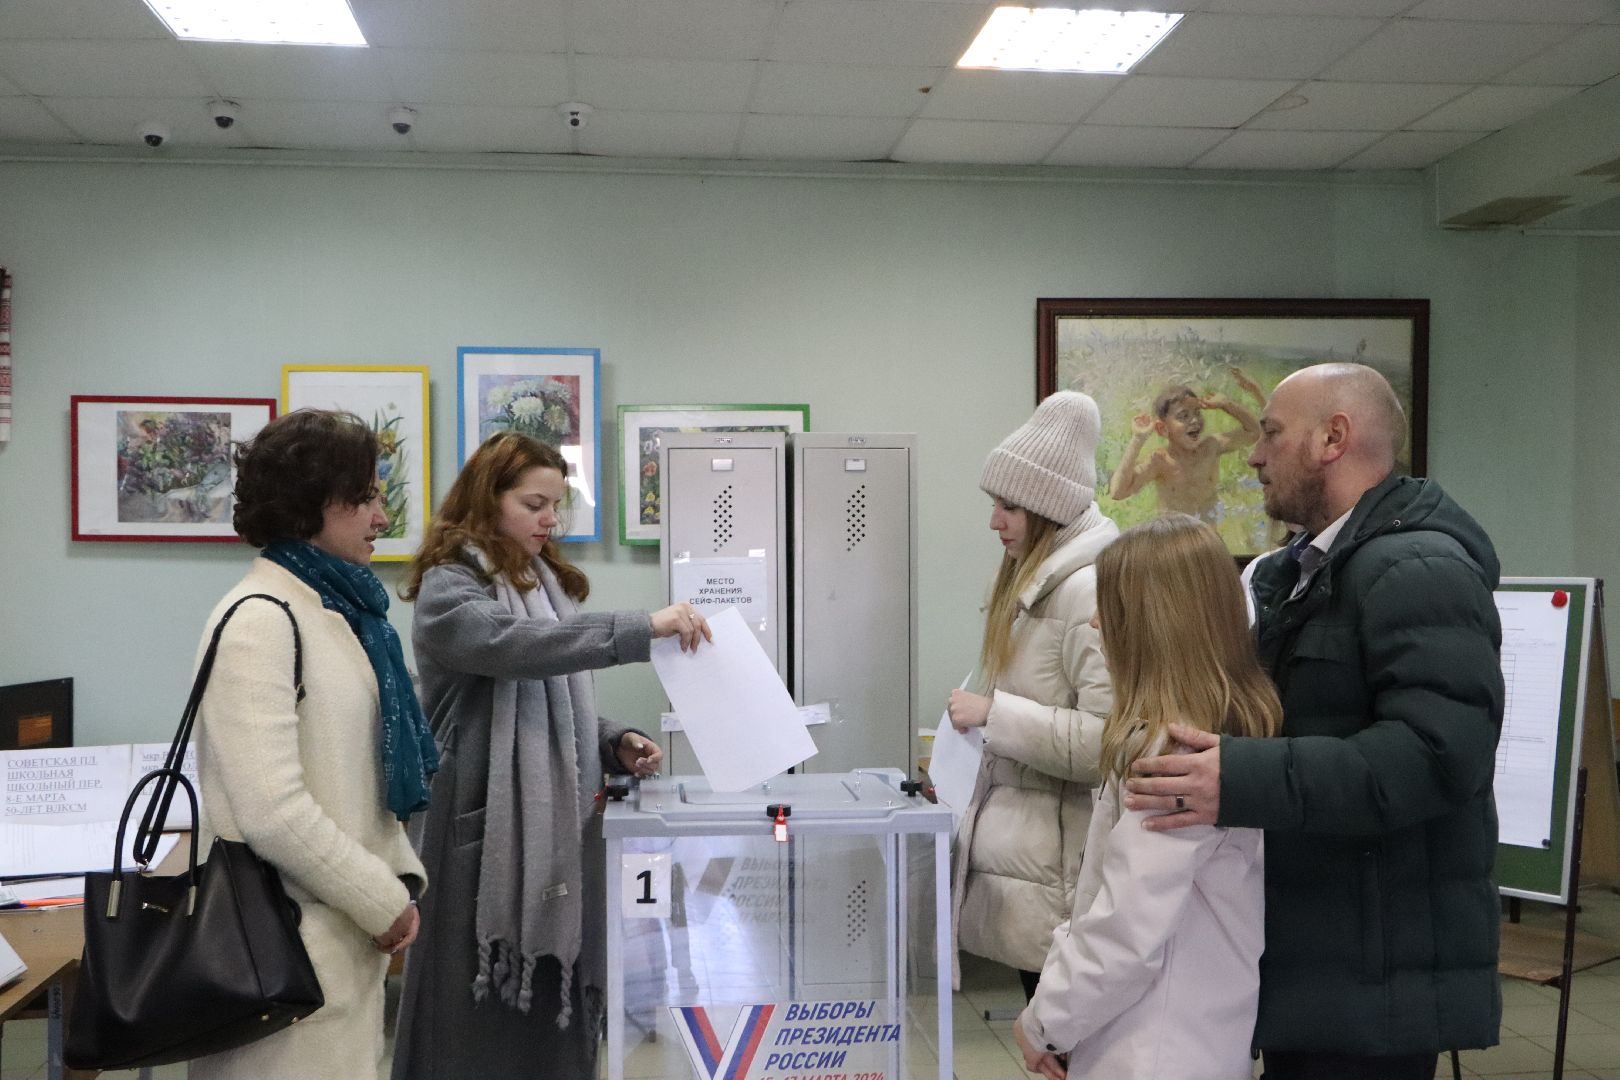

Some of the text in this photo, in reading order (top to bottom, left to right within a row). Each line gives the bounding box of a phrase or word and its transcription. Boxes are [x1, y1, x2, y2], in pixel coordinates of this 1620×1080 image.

[699, 587, 743, 595] ХРАНЕНИЯ
[689, 596, 752, 605] СЕЙФ-ПАКЕТОВ
[8, 756, 77, 769] СОВЕТСКАЯ
[8, 769, 74, 780] ШКОЛЬНАЯ
[7, 779, 76, 792] ШКОЛЬНЫЙ
[26, 793, 67, 802] МАРТА
[5, 802, 88, 816] 50-ЛЕТ ВЛКСМ
[636, 870, 657, 904] 1
[785, 1001, 876, 1021] ВЫБОРЫ
[775, 1024, 901, 1047] ПРЕЗИДЕНТА
[764, 1050, 847, 1071] РОССИИ
